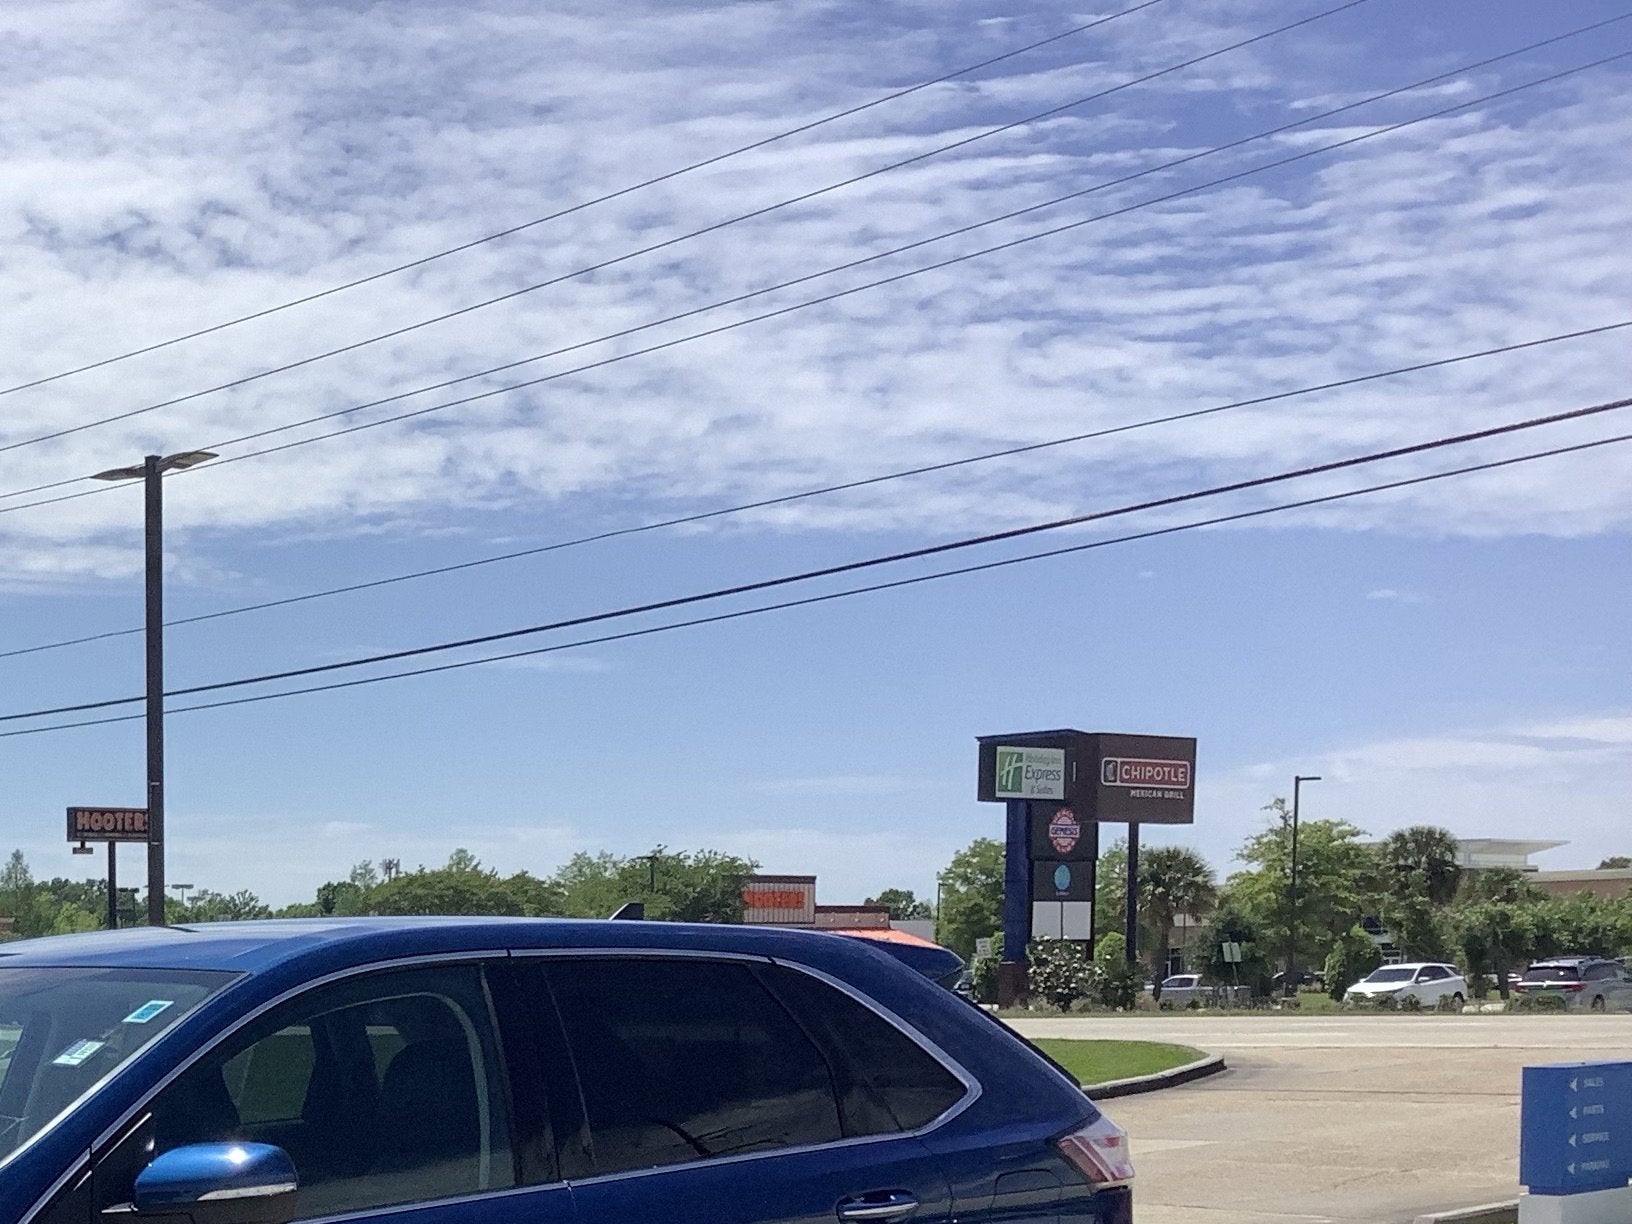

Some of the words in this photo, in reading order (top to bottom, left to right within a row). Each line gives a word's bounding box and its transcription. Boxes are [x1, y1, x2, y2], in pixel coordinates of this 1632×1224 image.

[1025, 764, 1062, 783] Express
[1121, 765, 1187, 782] CHIPOTLE
[1130, 789, 1163, 798] MEXICAN
[1164, 791, 1184, 799] GRILL
